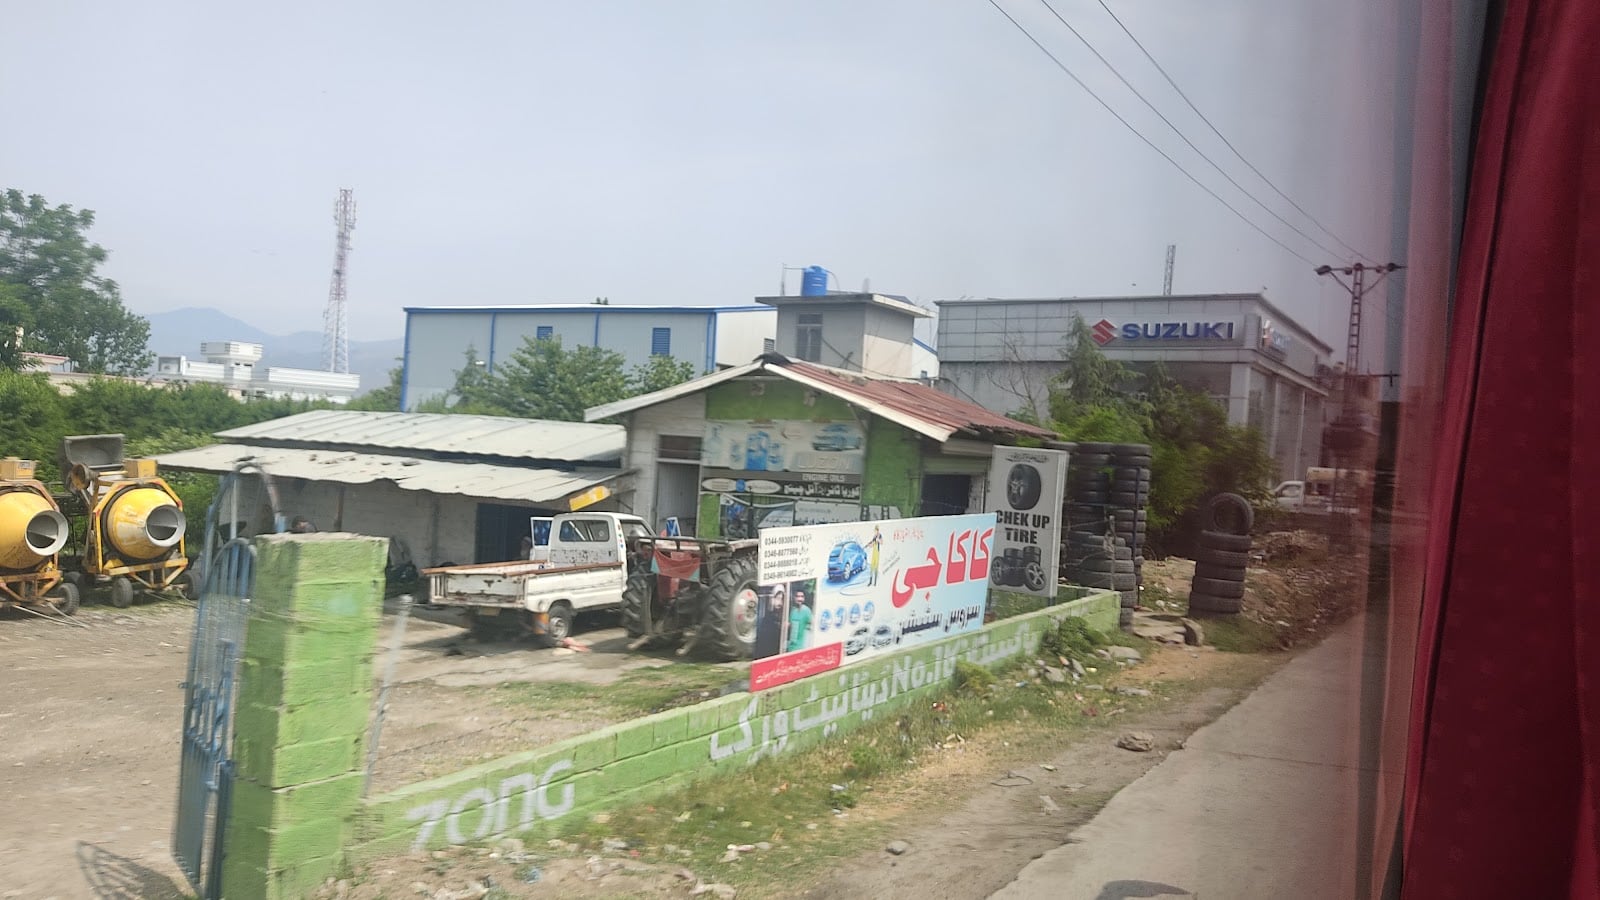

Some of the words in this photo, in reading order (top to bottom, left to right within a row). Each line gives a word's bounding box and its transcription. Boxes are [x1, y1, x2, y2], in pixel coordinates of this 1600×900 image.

[1122, 321, 1235, 341] SUZUKI
[996, 510, 1029, 528] CHEK
[1032, 514, 1050, 529] UP
